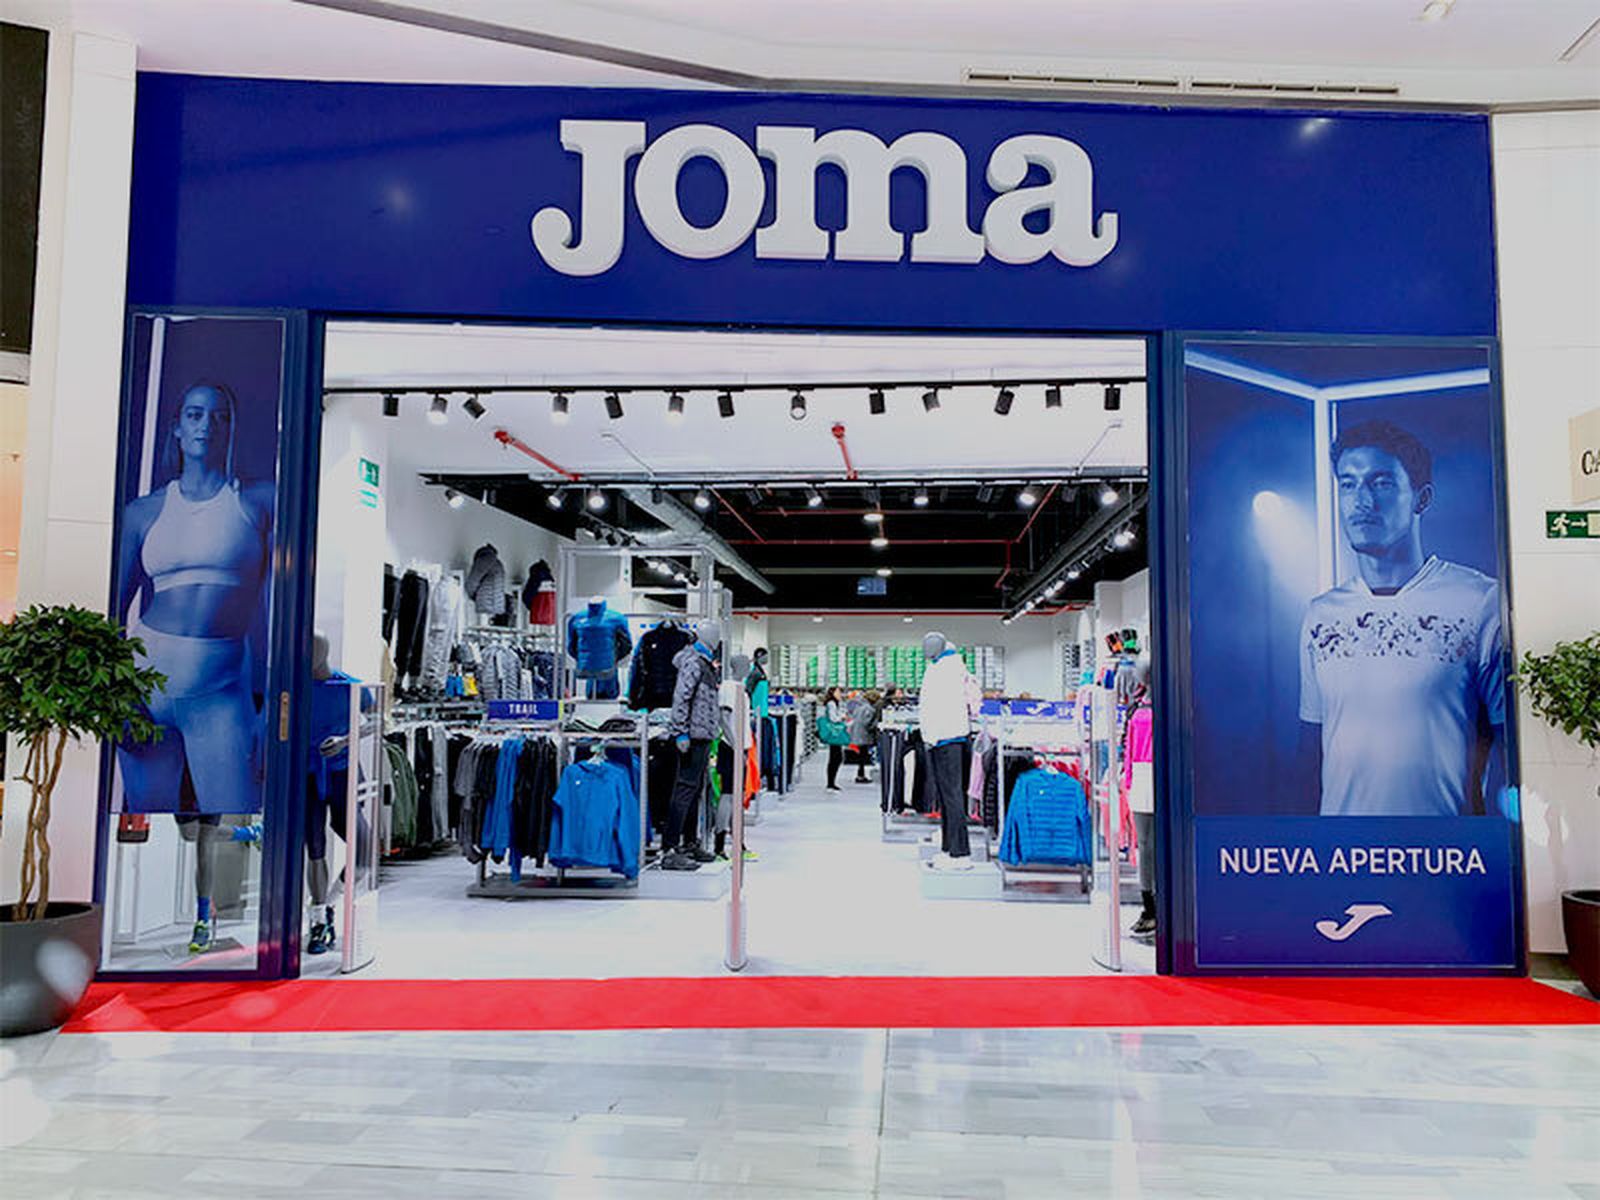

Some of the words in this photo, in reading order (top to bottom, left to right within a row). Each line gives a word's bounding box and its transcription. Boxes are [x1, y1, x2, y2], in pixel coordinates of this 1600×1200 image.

[509, 703, 539, 715] TRAIL
[1220, 847, 1320, 874] NUEVA
[1328, 847, 1487, 874] APERTURA
